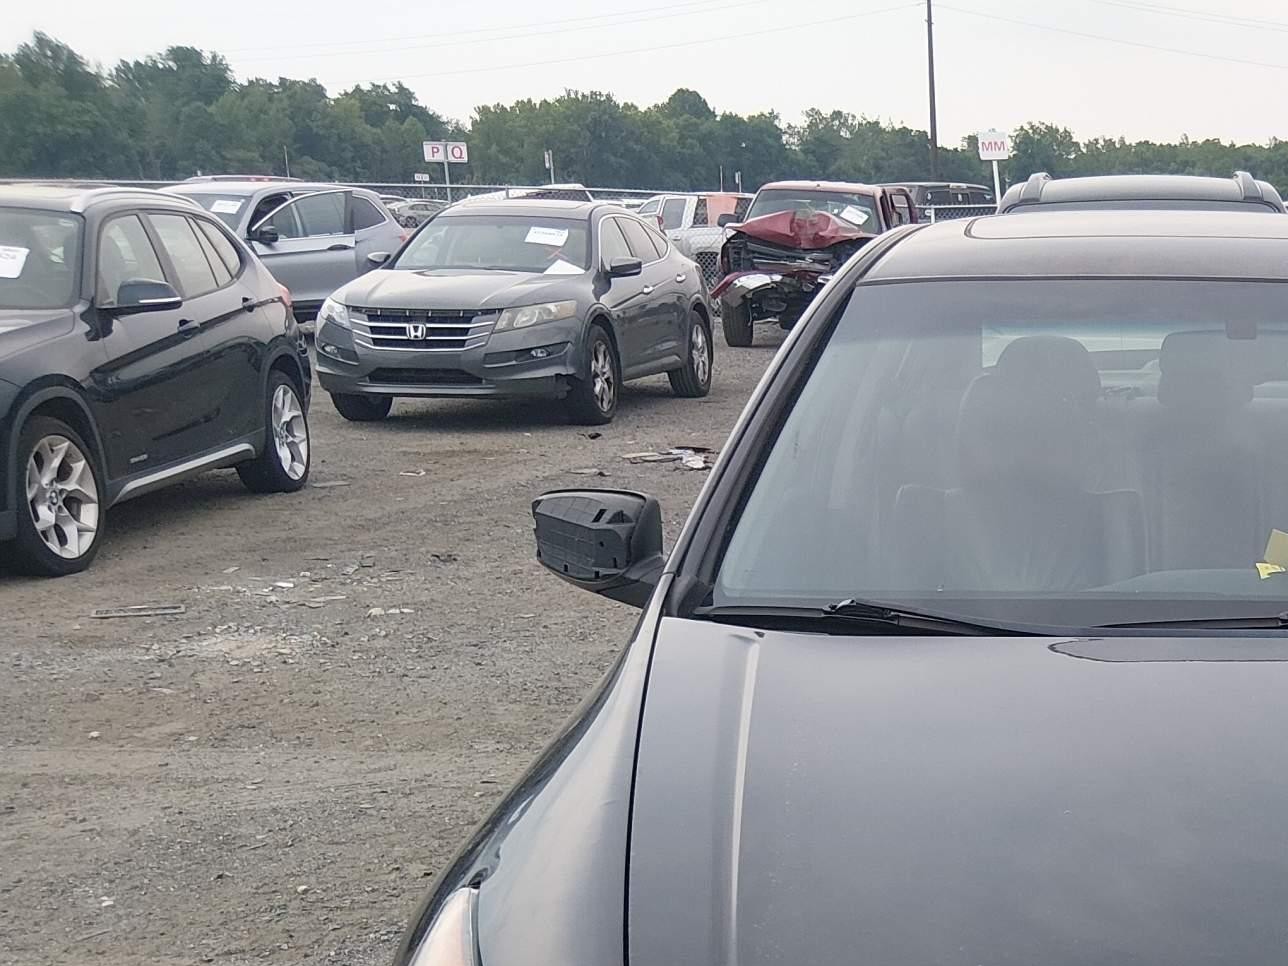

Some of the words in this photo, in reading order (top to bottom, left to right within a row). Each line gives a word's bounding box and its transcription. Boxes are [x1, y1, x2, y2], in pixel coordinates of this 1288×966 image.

[431, 146, 440, 158] P
[451, 146, 464, 159] Q
[982, 141, 1005, 152] MM
